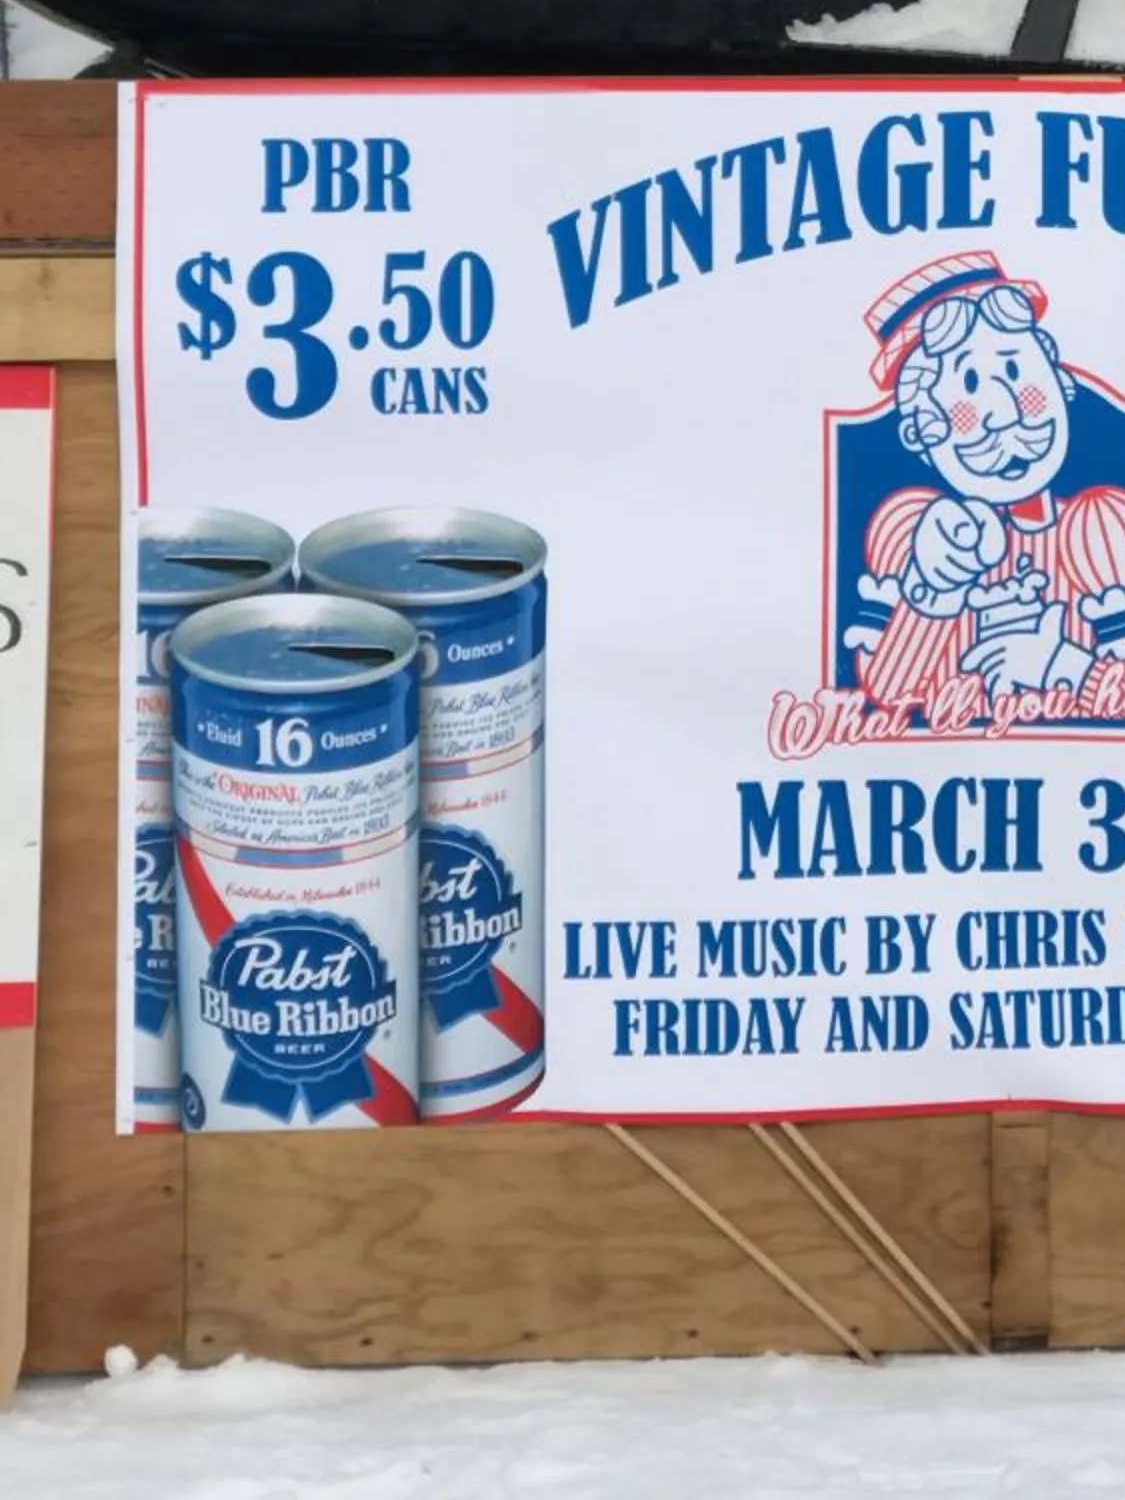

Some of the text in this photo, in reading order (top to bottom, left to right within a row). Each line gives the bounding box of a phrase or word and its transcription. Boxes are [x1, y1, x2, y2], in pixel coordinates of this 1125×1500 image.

[263, 137, 411, 213] PBR
[546, 110, 995, 327] VINTAGE
[176, 250, 495, 421] $3.50
[371, 366, 490, 415] CANS
[447, 642, 504, 663] Ounces
[985, 687, 1073, 739] you
[206, 717, 377, 767] Fluid 16 Ounces
[738, 777, 1042, 880] MARCH
[420, 858, 483, 904] bst
[421, 907, 520, 949] ibbon
[564, 921, 676, 979] LIVE
[698, 916, 847, 977] MUSIC
[867, 915, 936, 974] BY
[956, 910, 1107, 969] CHRIS
[233, 936, 356, 990] Pabst
[202, 984, 396, 1037] Blue Ribbon
[614, 997, 807, 1057] FRIDAY
[824, 994, 929, 1053] AND
[274, 1043, 326, 1053] BEER
